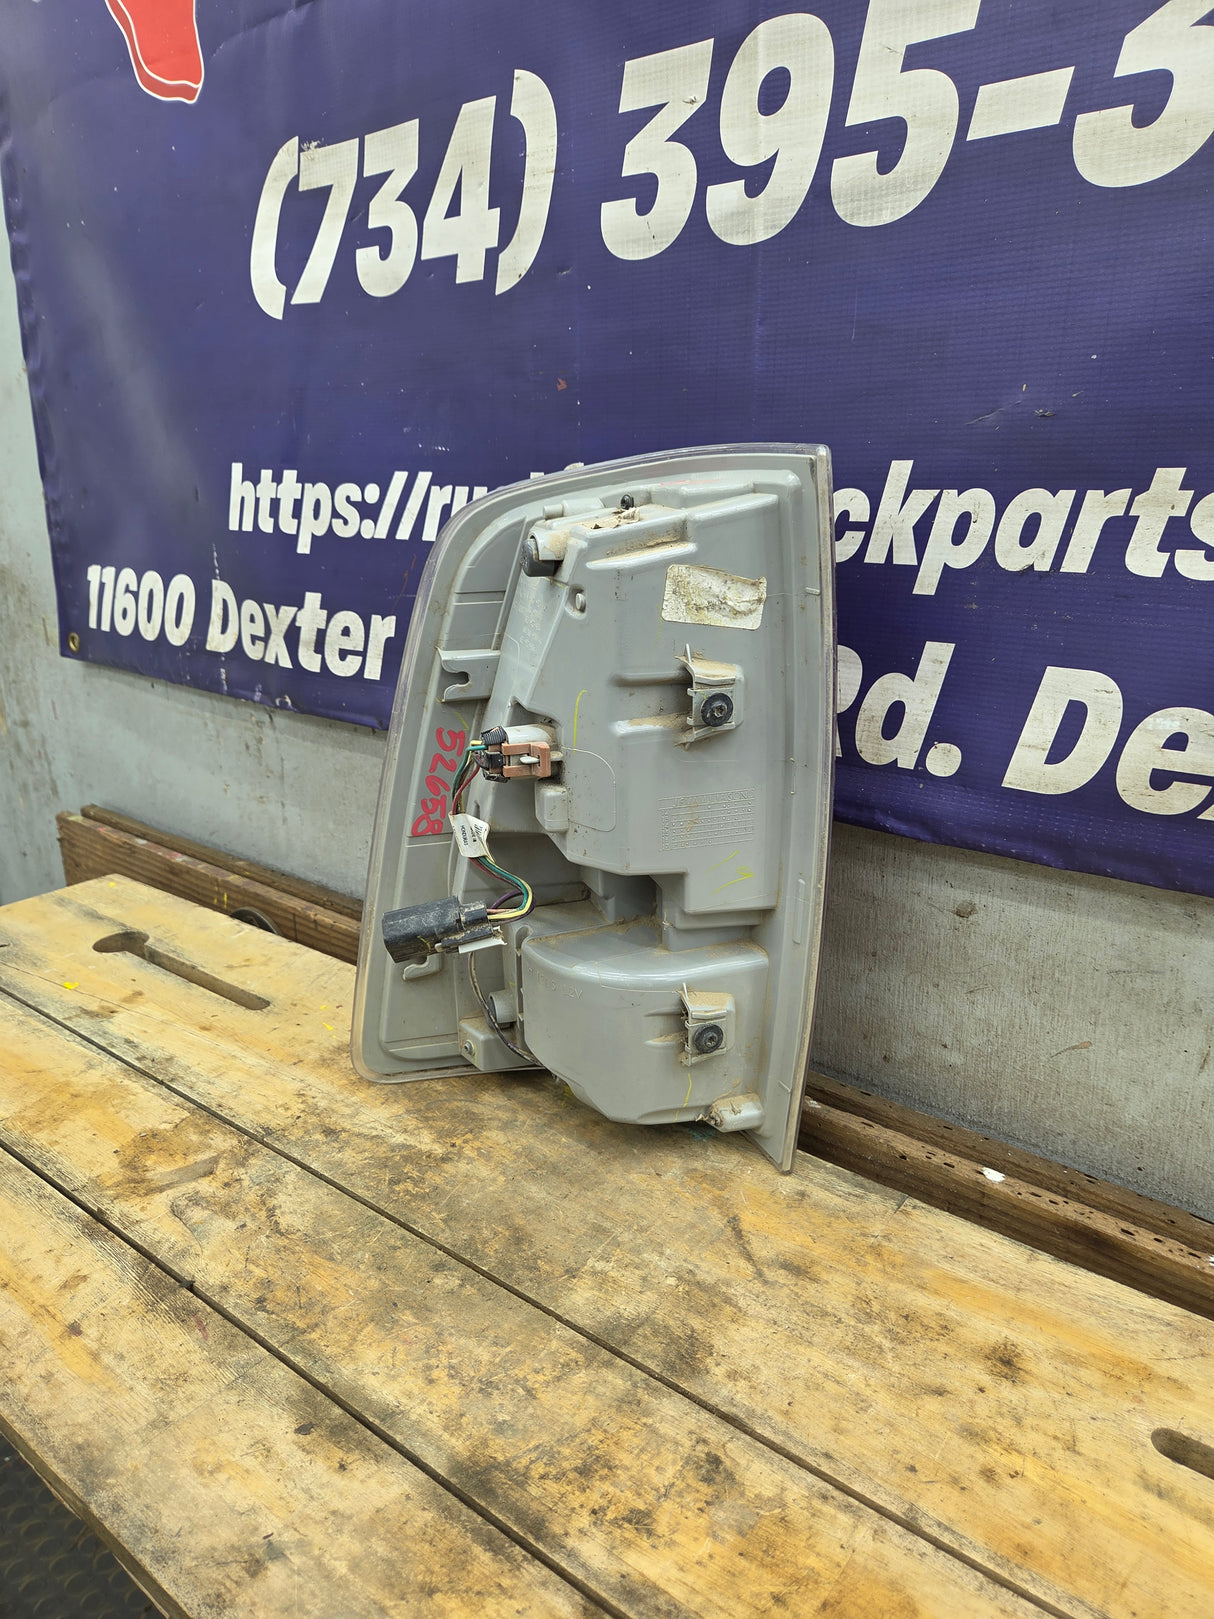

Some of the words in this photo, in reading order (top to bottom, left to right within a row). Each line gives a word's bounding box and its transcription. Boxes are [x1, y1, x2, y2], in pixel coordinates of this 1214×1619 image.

[250, 69, 557, 320] (734)
[87, 565, 195, 646] 11600
[206, 579, 396, 680] Dexter
[411, 727, 465, 837] 52658
